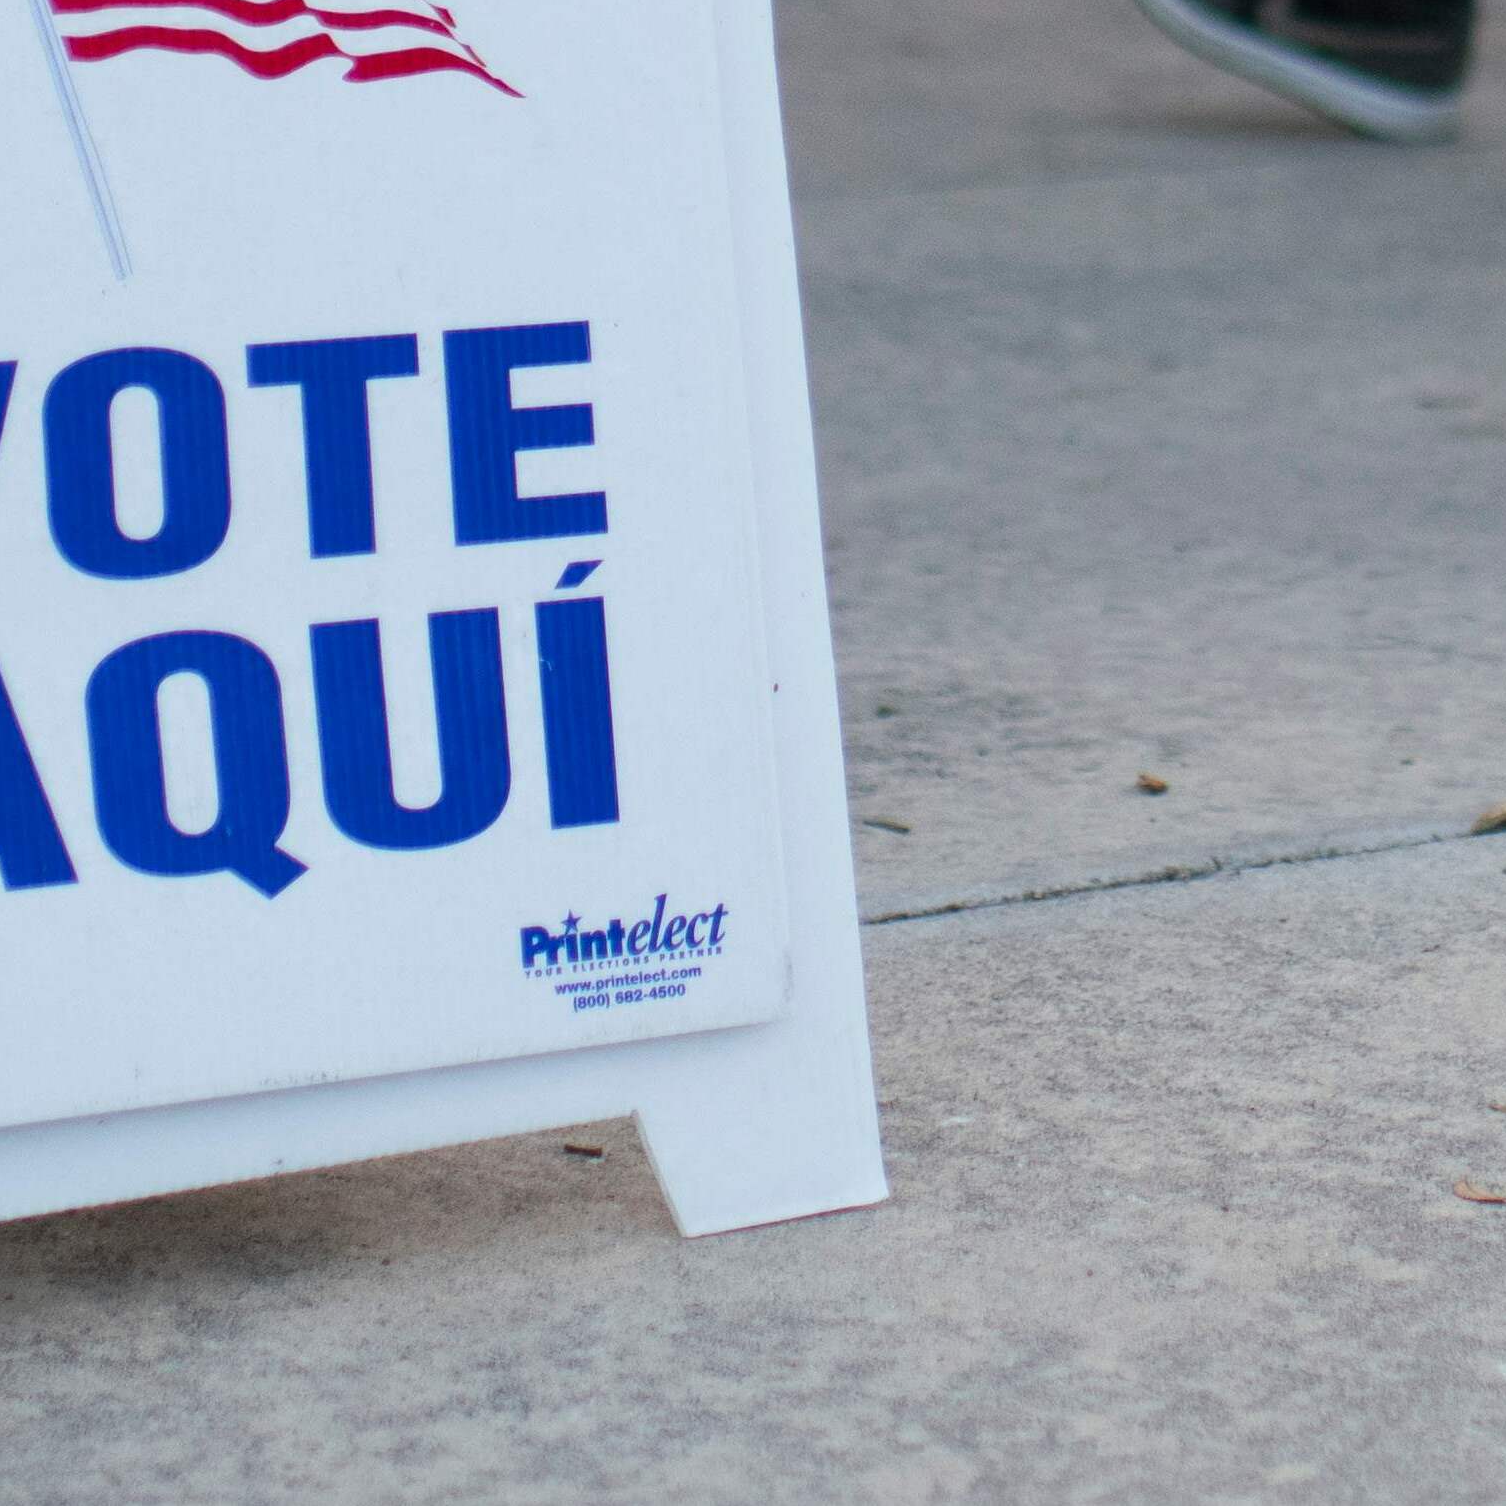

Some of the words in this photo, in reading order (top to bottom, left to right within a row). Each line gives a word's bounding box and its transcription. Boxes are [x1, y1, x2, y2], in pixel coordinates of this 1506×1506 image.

[520, 893, 729, 969] Printelect
[525, 967, 563, 979] YOUR
[572, 956, 651, 973] ELECTIONS
[659, 946, 723, 963] PARTNER
[555, 966, 702, 994] www.printelect.com
[573, 993, 611, 1012] (800)
[615, 983, 687, 1005] 682-4500
